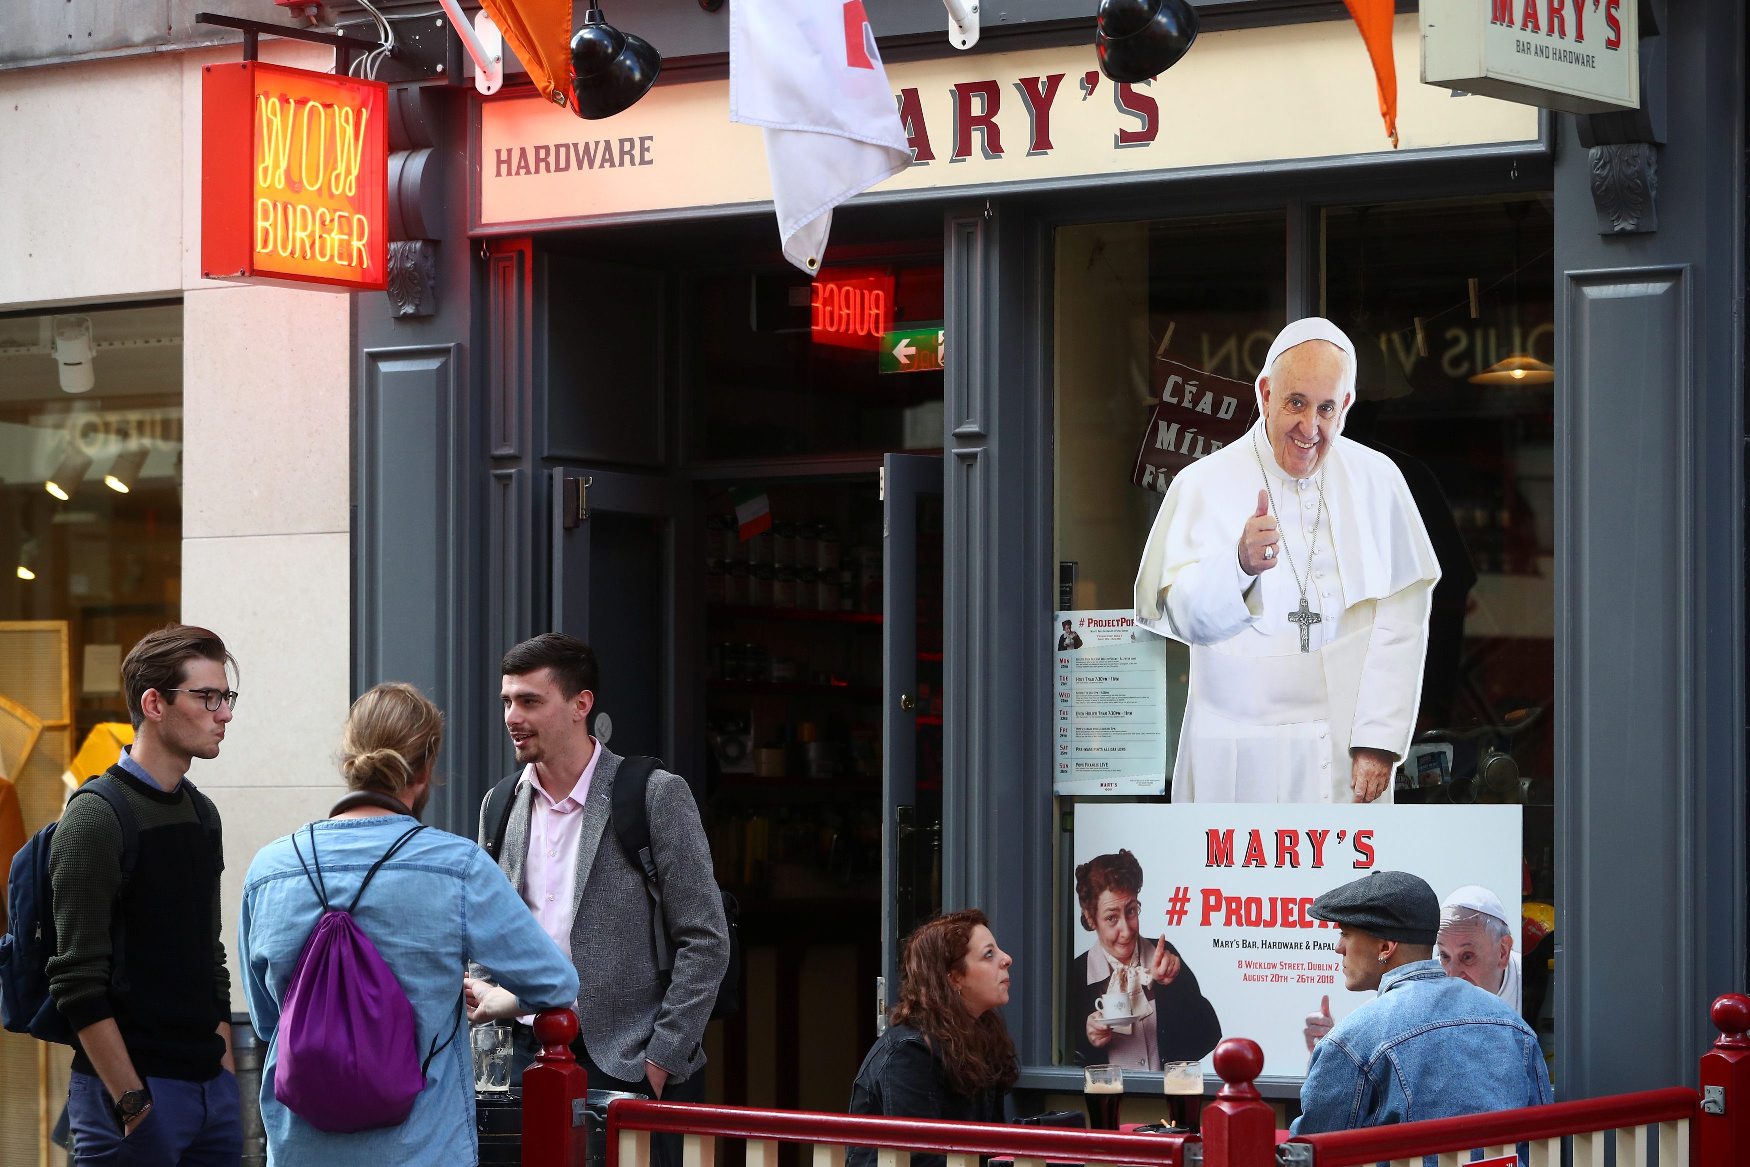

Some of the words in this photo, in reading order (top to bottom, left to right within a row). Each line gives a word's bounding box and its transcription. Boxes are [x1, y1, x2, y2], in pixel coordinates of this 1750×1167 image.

[1515, 39, 1532, 56] BAR
[1534, 44, 1550, 59] AND
[1552, 47, 1597, 69] HARDWARE
[895, 70, 1159, 166] ARY'S
[257, 94, 367, 197] WOW
[495, 135, 654, 178] HARDWARE
[256, 198, 369, 269] BURGER
[1205, 829, 1375, 869] MARY'S
[1212, 938, 1240, 949] MARY'S
[1261, 939, 1304, 950] HARDWARE
[1305, 940, 1311, 950] &
[1312, 940, 1336, 951] PAPAL
[1237, 960, 1243, 969] 8
[1244, 960, 1278, 970] WICKLOW
[1307, 961, 1333, 971] DUBLIN
[1334, 962, 1340, 972] 2
[1242, 972, 1269, 982] AUGUST
[1269, 973, 1289, 983] 20TH
[1296, 974, 1315, 984] 26TH
[1316, 974, 1335, 984] 2018
